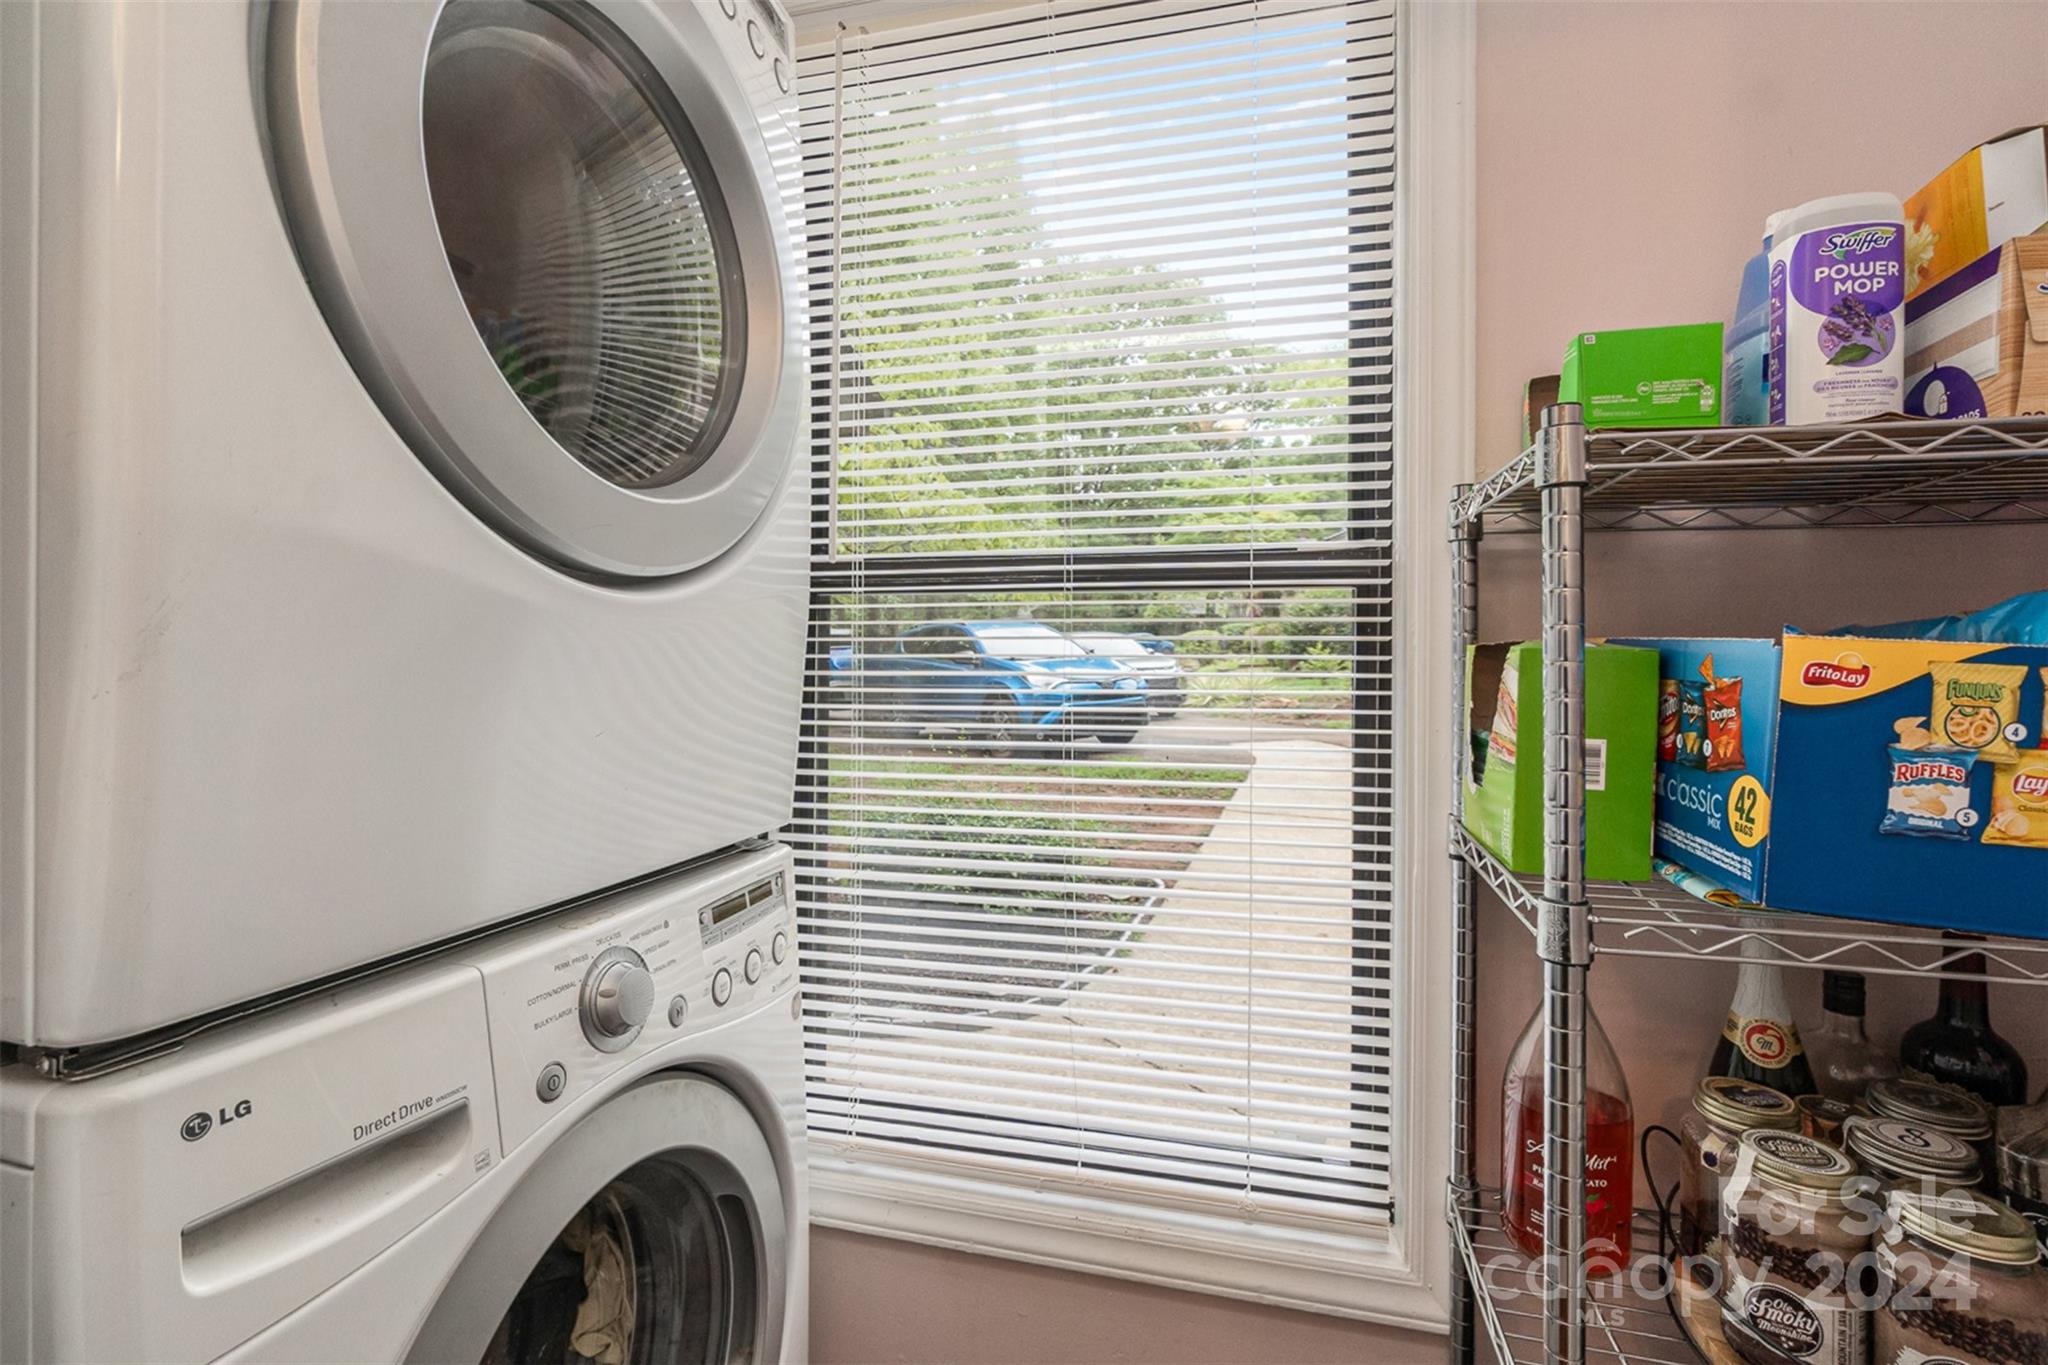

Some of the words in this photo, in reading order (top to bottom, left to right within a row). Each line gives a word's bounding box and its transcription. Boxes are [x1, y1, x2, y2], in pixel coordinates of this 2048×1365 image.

[1819, 231, 1893, 254] Swiffer
[1814, 261, 1899, 283] POWER
[1834, 277, 1885, 296] MOP
[1711, 707, 1737, 721] Doritos
[2011, 727, 2020, 739] 4
[1896, 763, 1965, 782] RUFFLES
[1735, 786, 1758, 825] 42
[1707, 817, 1721, 830] MIX
[1963, 812, 1970, 823] 5
[1734, 821, 1754, 838] BAGS
[219, 1099, 252, 1126] LG
[353, 1111, 397, 1141] Direct
[398, 1096, 434, 1120] Drive
[1773, 1299, 1793, 1311] Ole
[1749, 1298, 1818, 1334] Smoky
[1757, 1319, 1816, 1343] Moonshine
